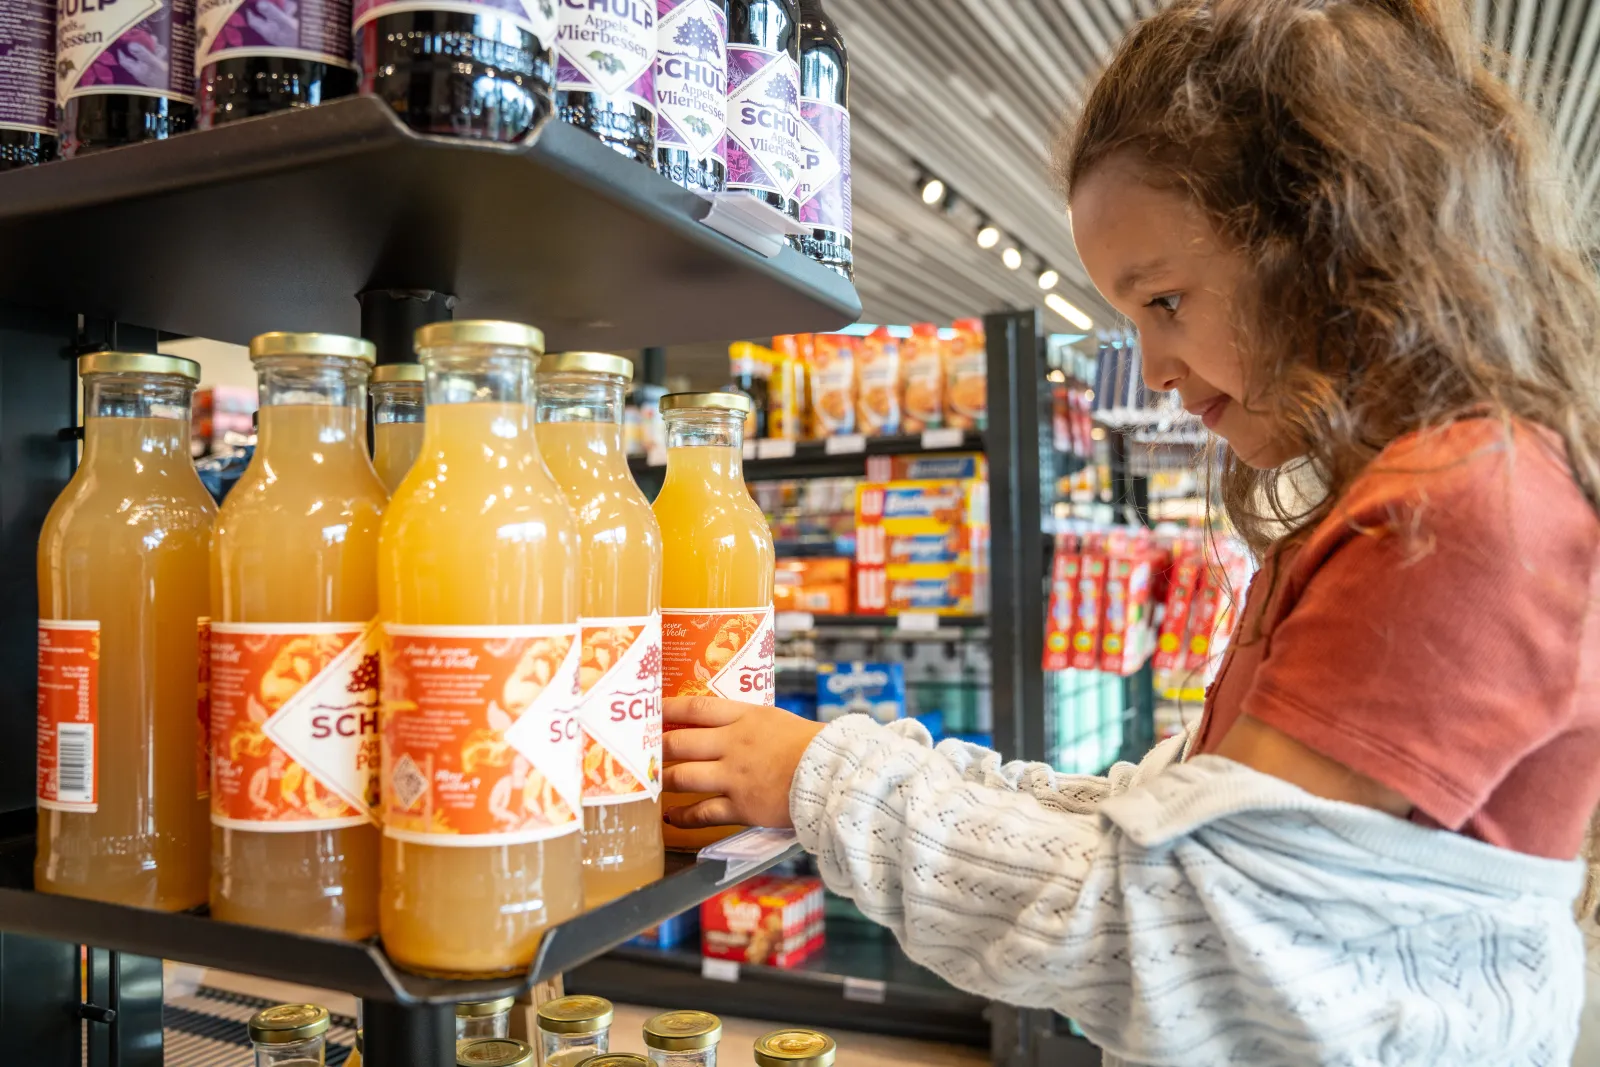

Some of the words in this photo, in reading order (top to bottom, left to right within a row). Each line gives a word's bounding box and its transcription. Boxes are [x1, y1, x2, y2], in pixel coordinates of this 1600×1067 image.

[585, 14, 628, 34] Appels
[558, 24, 648, 60] Vlierbessen
[681, 83, 713, 102] Appels
[666, 628, 686, 637] Vecht
[312, 711, 378, 739] SCH
